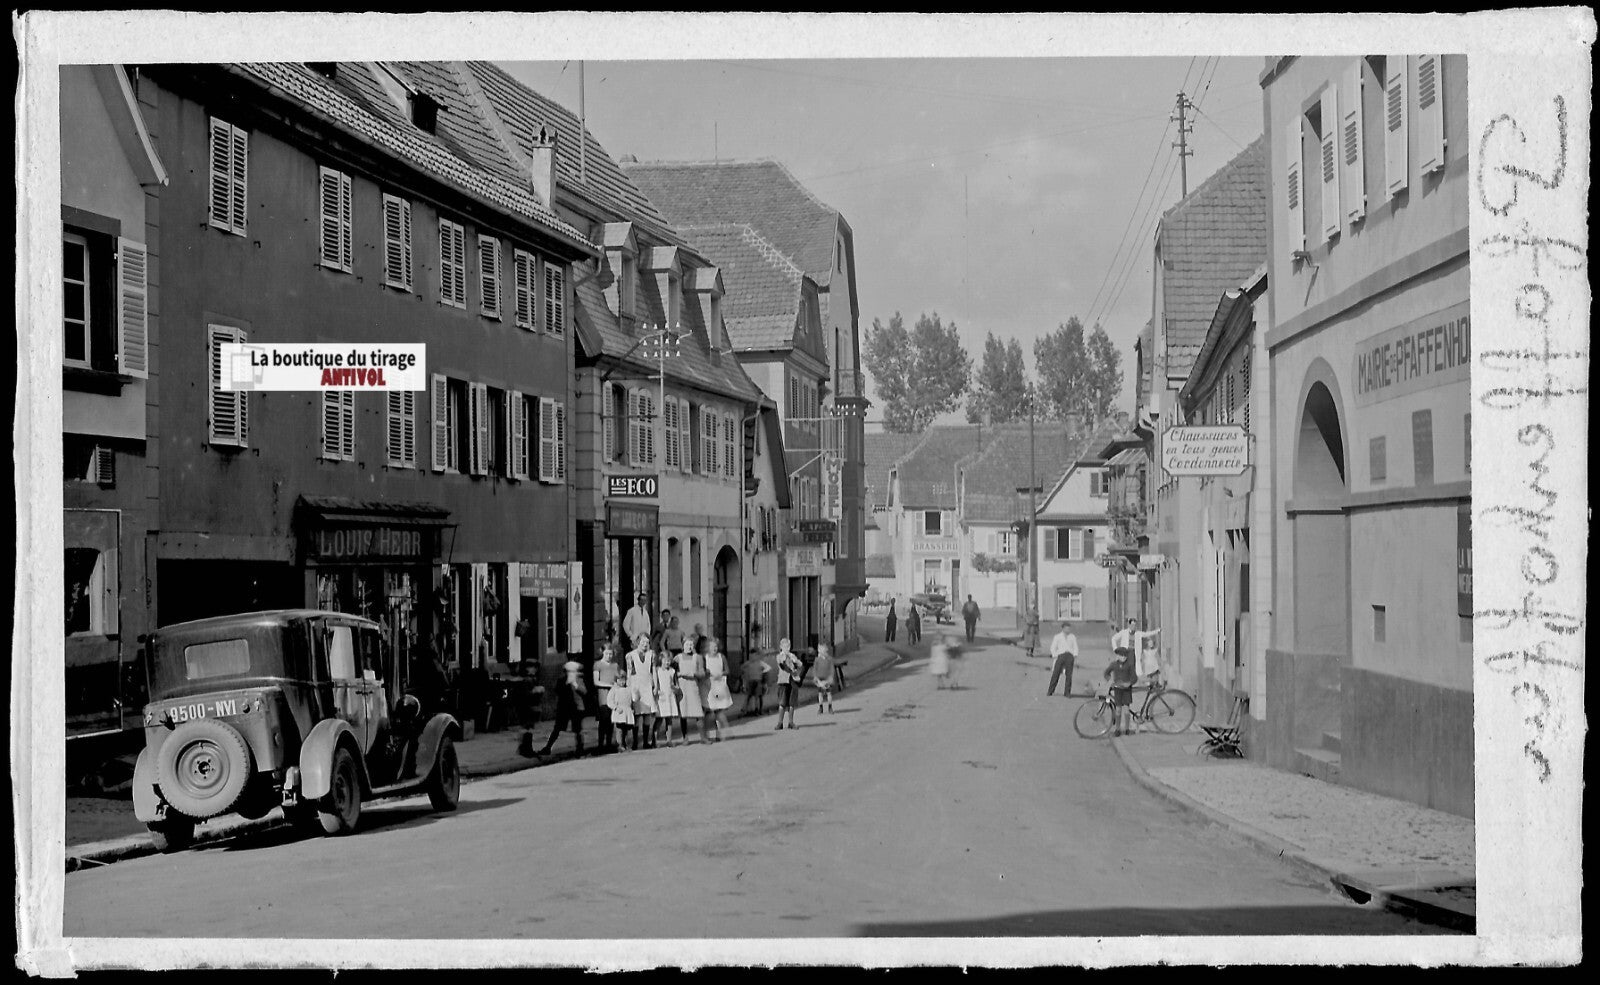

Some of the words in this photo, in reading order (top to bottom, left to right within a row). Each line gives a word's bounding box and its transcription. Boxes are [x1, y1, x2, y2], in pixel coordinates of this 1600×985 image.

[1358, 343, 1391, 395] MAIRIE
[1170, 428, 1238, 442] Chaussures
[1166, 446, 1177, 455] en
[1182, 443, 1205, 455] tous
[1169, 455, 1241, 469] Cordonnerie
[611, 478, 627, 487] LES
[627, 478, 656, 496] ECO
[319, 529, 374, 558] LOUIS
[379, 526, 421, 557] HERR
